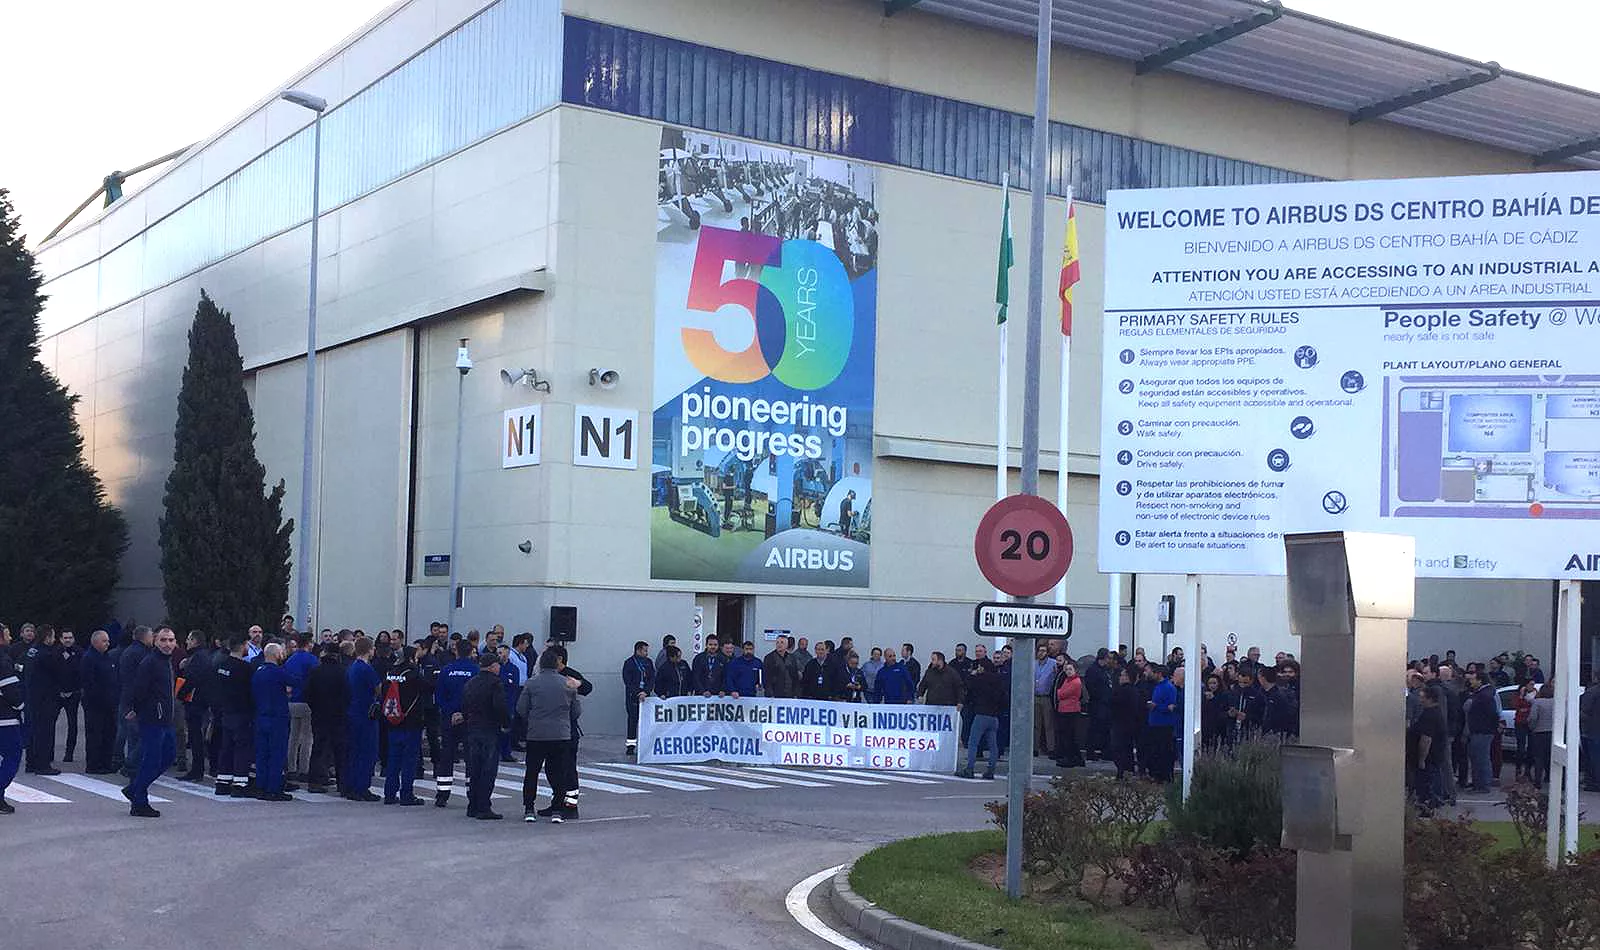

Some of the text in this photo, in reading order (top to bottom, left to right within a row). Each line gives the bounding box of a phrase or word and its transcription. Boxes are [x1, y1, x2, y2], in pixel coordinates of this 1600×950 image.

[1118, 192, 1600, 229] WELCOME TO AIRBUS DS CENTRO BAHÍA DE
[1184, 228, 1579, 254] BIENVENIDO A AIRBUS DS CENTRO BAHÍA DE CÁDIZ
[1152, 269, 1240, 284] ATTENTION
[1246, 268, 1279, 281] YOU
[1284, 267, 1316, 280] ARE
[1322, 265, 1417, 279] ACCESSING
[1424, 264, 1445, 276] TO
[1450, 263, 1474, 276] AN
[1480, 261, 1582, 275] INDUSTRIAL
[1188, 288, 1254, 302] ATENCIÓN
[1258, 289, 1300, 301] USTED
[1304, 285, 1338, 299] ESTÁ
[1341, 286, 1430, 298] ACCEDIENDO
[1432, 286, 1442, 296] A
[1446, 285, 1466, 296] UN
[1511, 282, 1592, 294] INDUSTRIAL
[681, 225, 855, 391] 50
[795, 267, 818, 359] YEARS
[1120, 312, 1299, 327] PRIMARY SAFETY RULES
[1384, 310, 1461, 330] People
[1468, 309, 1541, 330] Safety
[1548, 308, 1567, 326] @
[1119, 326, 1286, 336] REGLAS ELEMENTALES DE SEGURIDAD
[1384, 331, 1494, 342] nearly safe is not safe
[1383, 360, 1562, 370] PLANT LAYOUT/PLANO GENERAL
[1139, 378, 1176, 387] Asegurar
[1196, 378, 1220, 386] todos
[1236, 378, 1270, 386] equipos
[682, 386, 847, 436] pioneering
[1138, 400, 1159, 408] Keep
[1138, 420, 1172, 428] Caminar
[507, 414, 535, 457] N1
[580, 416, 632, 460] N1
[681, 424, 822, 462] progress
[1136, 450, 1174, 458] Conducir
[1136, 480, 1174, 488] Respetar
[1176, 480, 1188, 488] las
[1190, 480, 1246, 489] prohibiciones
[1248, 480, 1259, 488] de
[1144, 490, 1154, 498] de
[1156, 490, 1184, 498] utilizar
[1186, 491, 1222, 500] aparatos
[1136, 502, 1240, 511] Respect non-smoking and
[1170, 512, 1179, 520] of
[1180, 512, 1219, 520] electronic
[1222, 512, 1248, 520] device
[1135, 530, 1156, 538] Estar
[1158, 530, 1182, 538] alerta
[1184, 530, 1208, 538] frente
[1218, 531, 1266, 539] situaciones
[1000, 530, 1050, 560] 20
[765, 548, 854, 571] AIRBUS
[1426, 557, 1448, 568] and
[985, 612, 1064, 630] EN TODA LA PLANTA
[654, 704, 672, 723] En
[677, 703, 744, 723] DEFENSA
[750, 706, 773, 724] del
[776, 706, 838, 727] EMPLEO
[854, 710, 868, 729] la
[872, 711, 953, 732] INDUSTRIA
[653, 734, 763, 756] AEROESPACIAL
[764, 730, 937, 750] COMITE DE EMPRESA
[783, 752, 844, 766] AIRBUS
[872, 755, 908, 768] CBC
